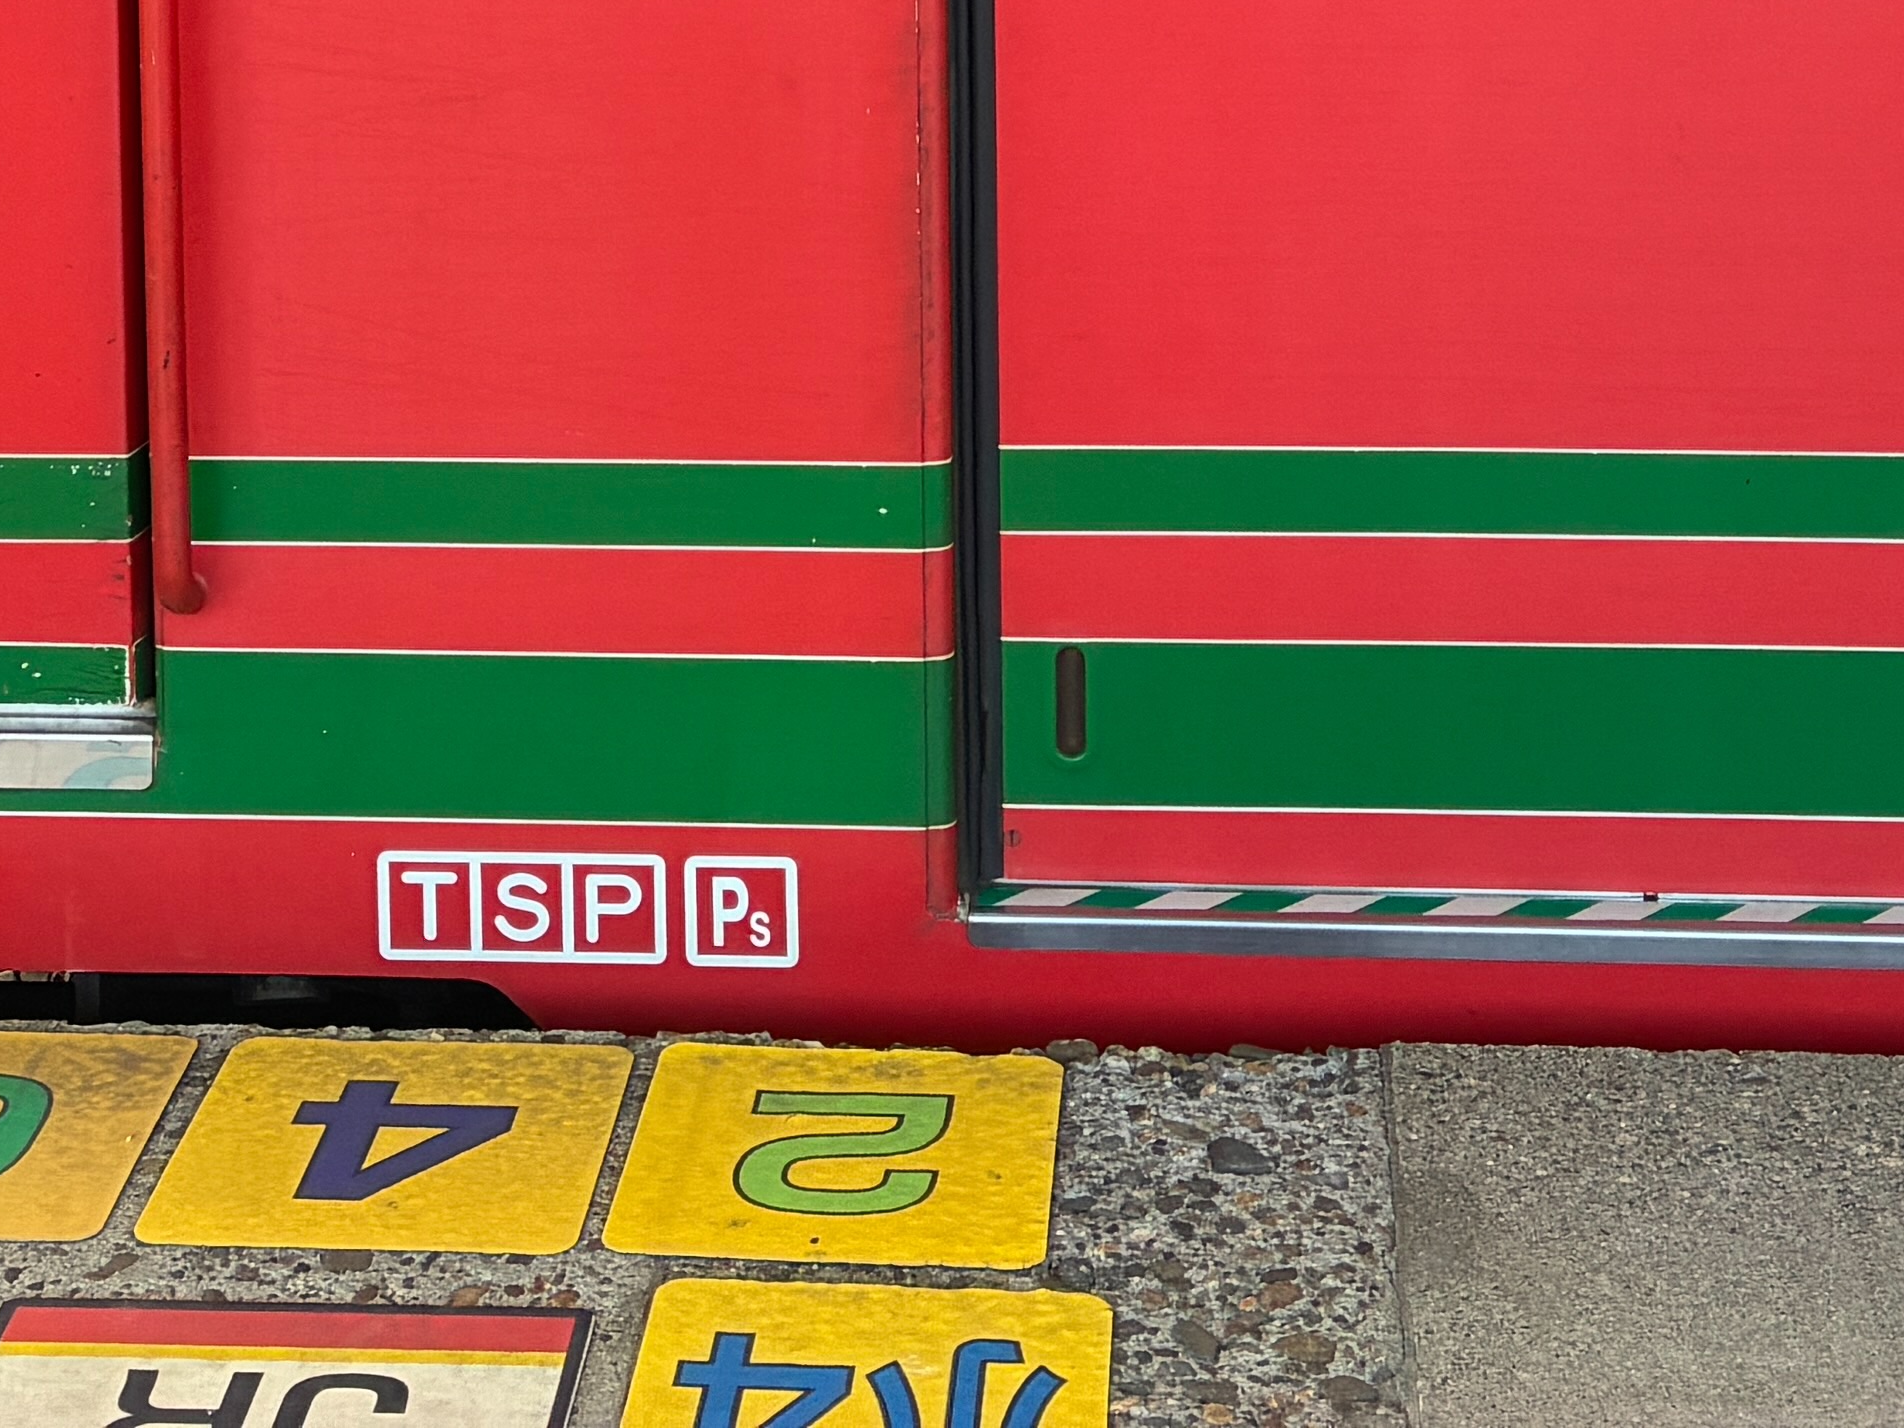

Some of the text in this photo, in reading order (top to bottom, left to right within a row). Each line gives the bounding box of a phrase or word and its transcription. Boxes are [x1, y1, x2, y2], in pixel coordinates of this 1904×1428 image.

[400, 870, 643, 944] TSP
[711, 875, 772, 948] Ps
[291, 1079, 519, 1201] 4
[732, 1089, 956, 1215] 2
